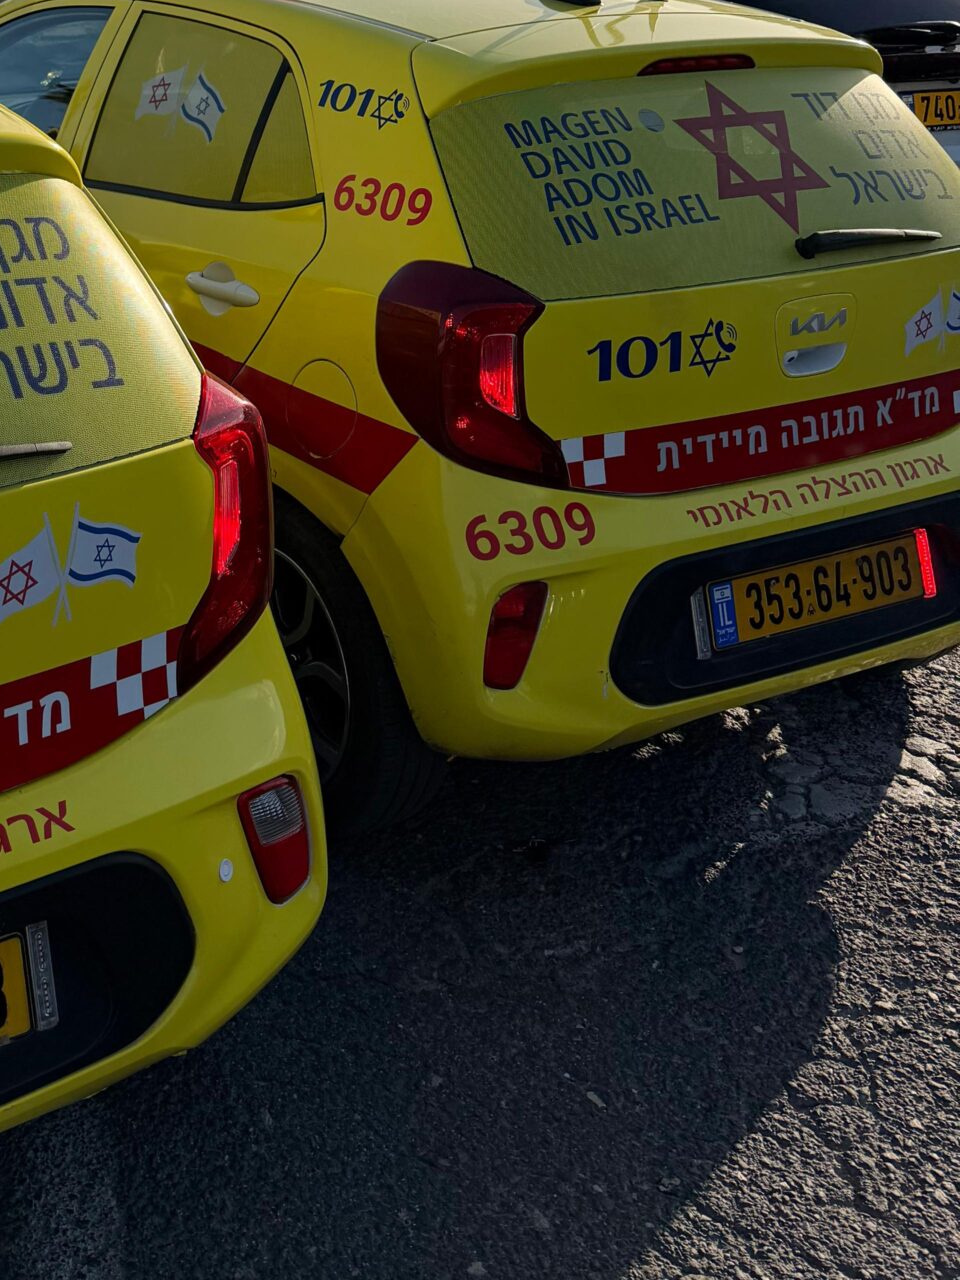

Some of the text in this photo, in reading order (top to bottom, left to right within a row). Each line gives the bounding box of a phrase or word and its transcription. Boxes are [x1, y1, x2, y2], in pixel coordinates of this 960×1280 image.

[318, 80, 374, 117] 101
[791, 92, 900, 125] מגן דוד
[504, 107, 633, 149] MAGEN
[849, 129, 929, 160] אדום
[522, 138, 632, 179] DAVID
[333, 175, 432, 226] 6309
[544, 169, 654, 211] ADOM
[829, 166, 954, 206] בישראל
[554, 194, 720, 246] IN ISRAEL
[587, 331, 683, 382] 101
[781, 404, 864, 449] תגובה
[656, 425, 767, 472] מיידית
[687, 454, 951, 529] ארגון ההצלה הלאומי
[465, 502, 596, 561] 6309
[718, 602, 733, 627] IL
